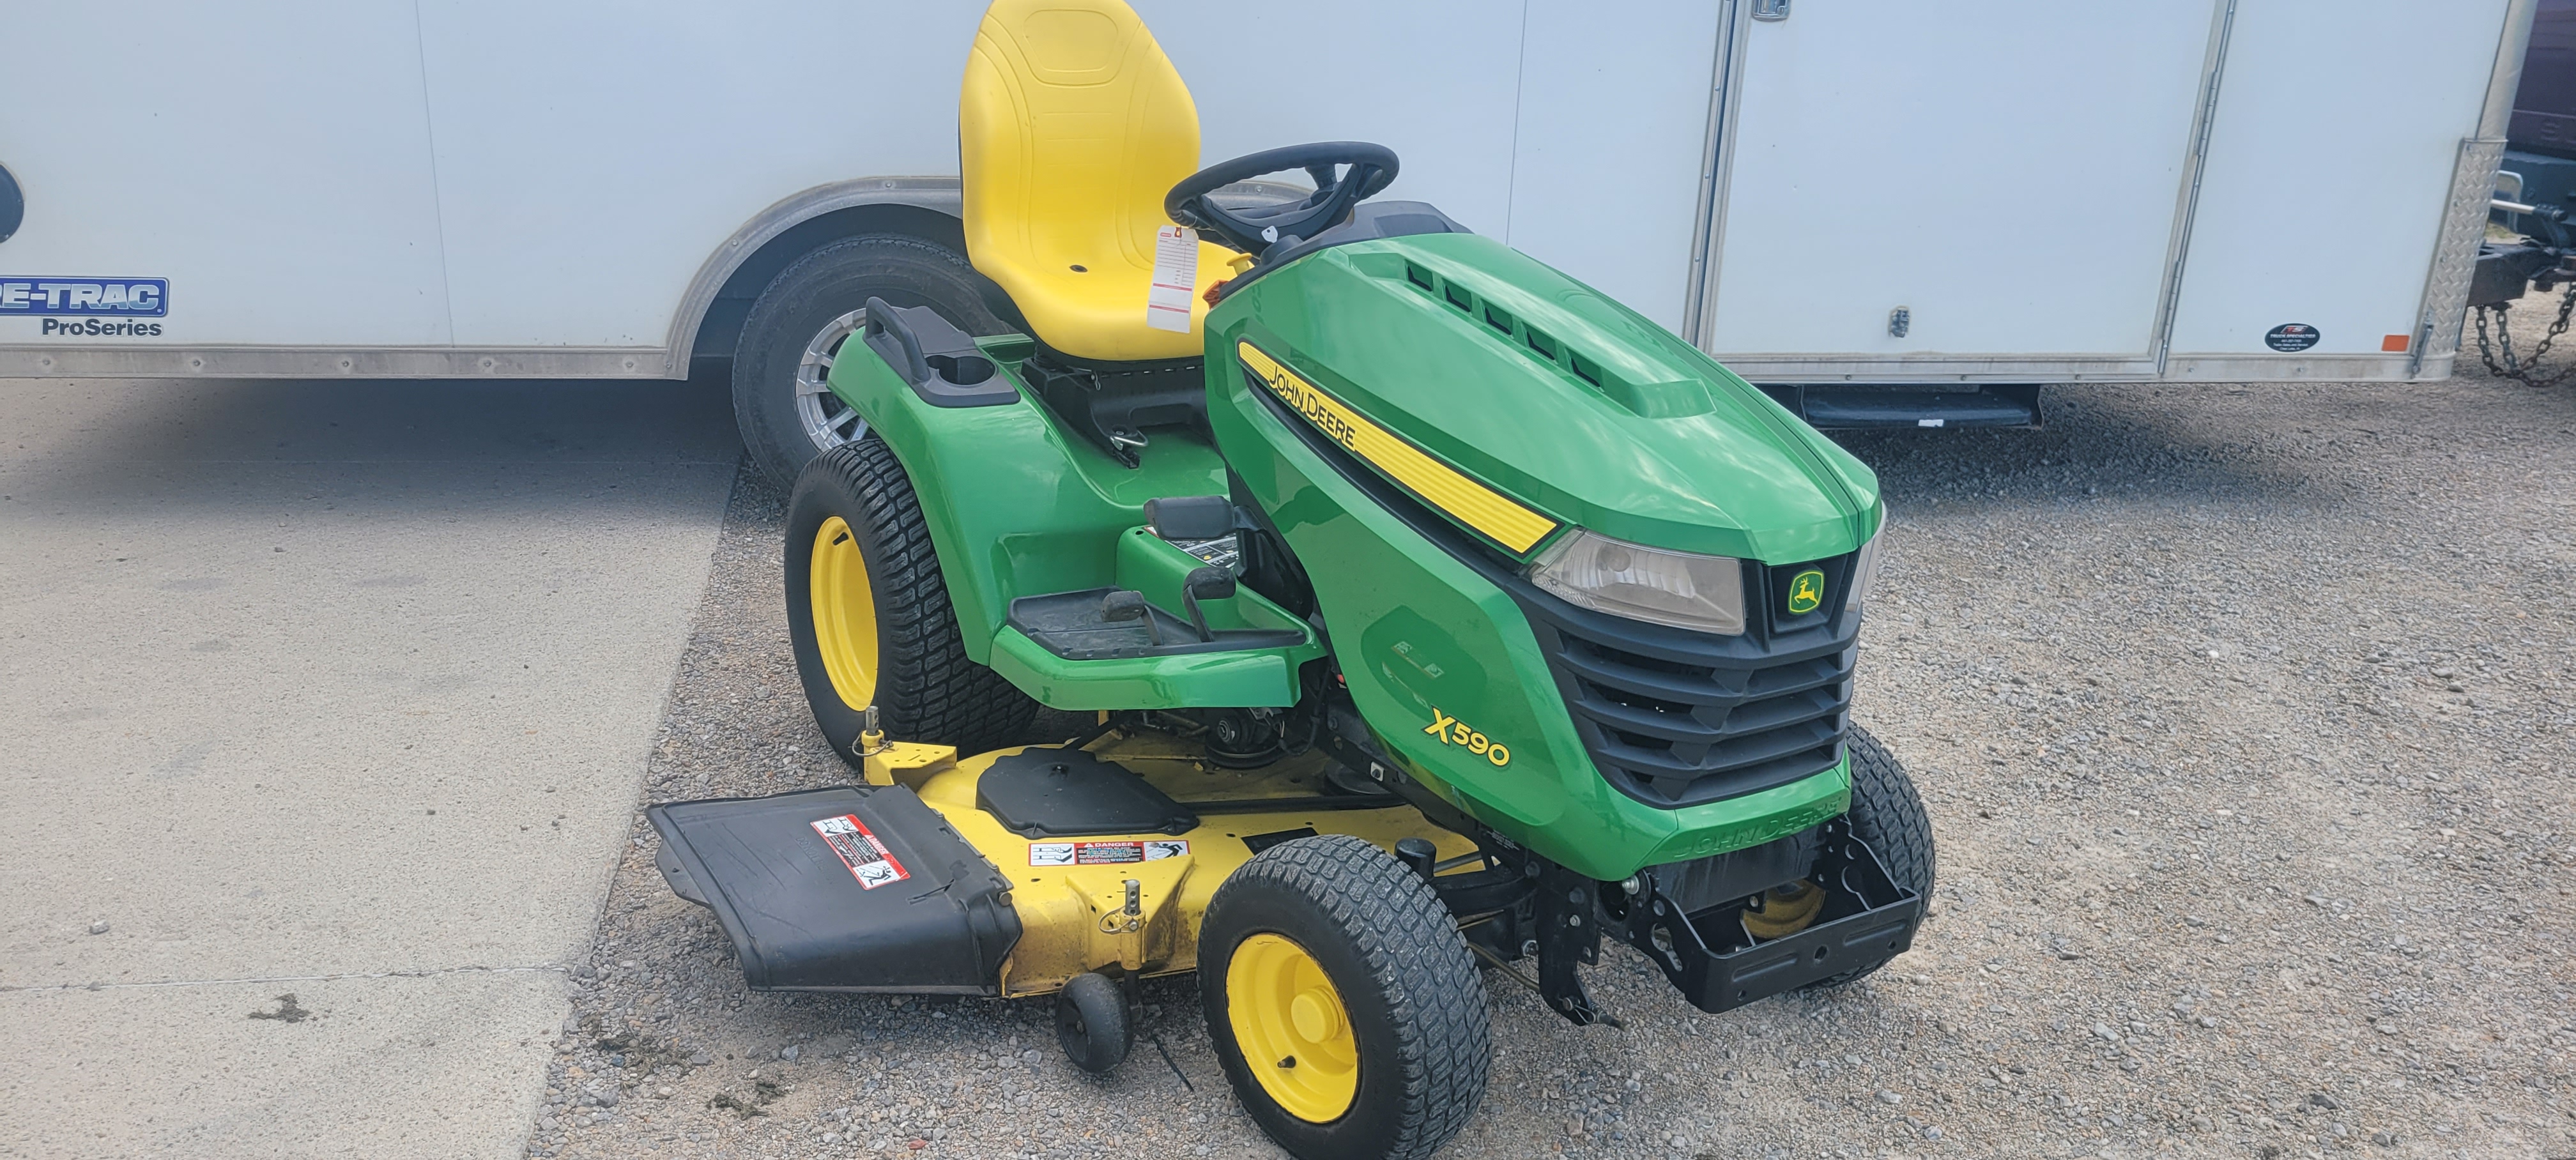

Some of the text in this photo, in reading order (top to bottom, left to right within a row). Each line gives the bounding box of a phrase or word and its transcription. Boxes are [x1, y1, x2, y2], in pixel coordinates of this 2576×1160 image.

[0, 283, 160, 310] E-TRAC
[42, 318, 162, 336] ProSeries
[1269, 365, 1356, 448] JOHN DEERE
[1422, 705, 1510, 767] X590
[869, 837, 889, 855] DANGER
[1673, 798, 1843, 858] JOHN DEERE
